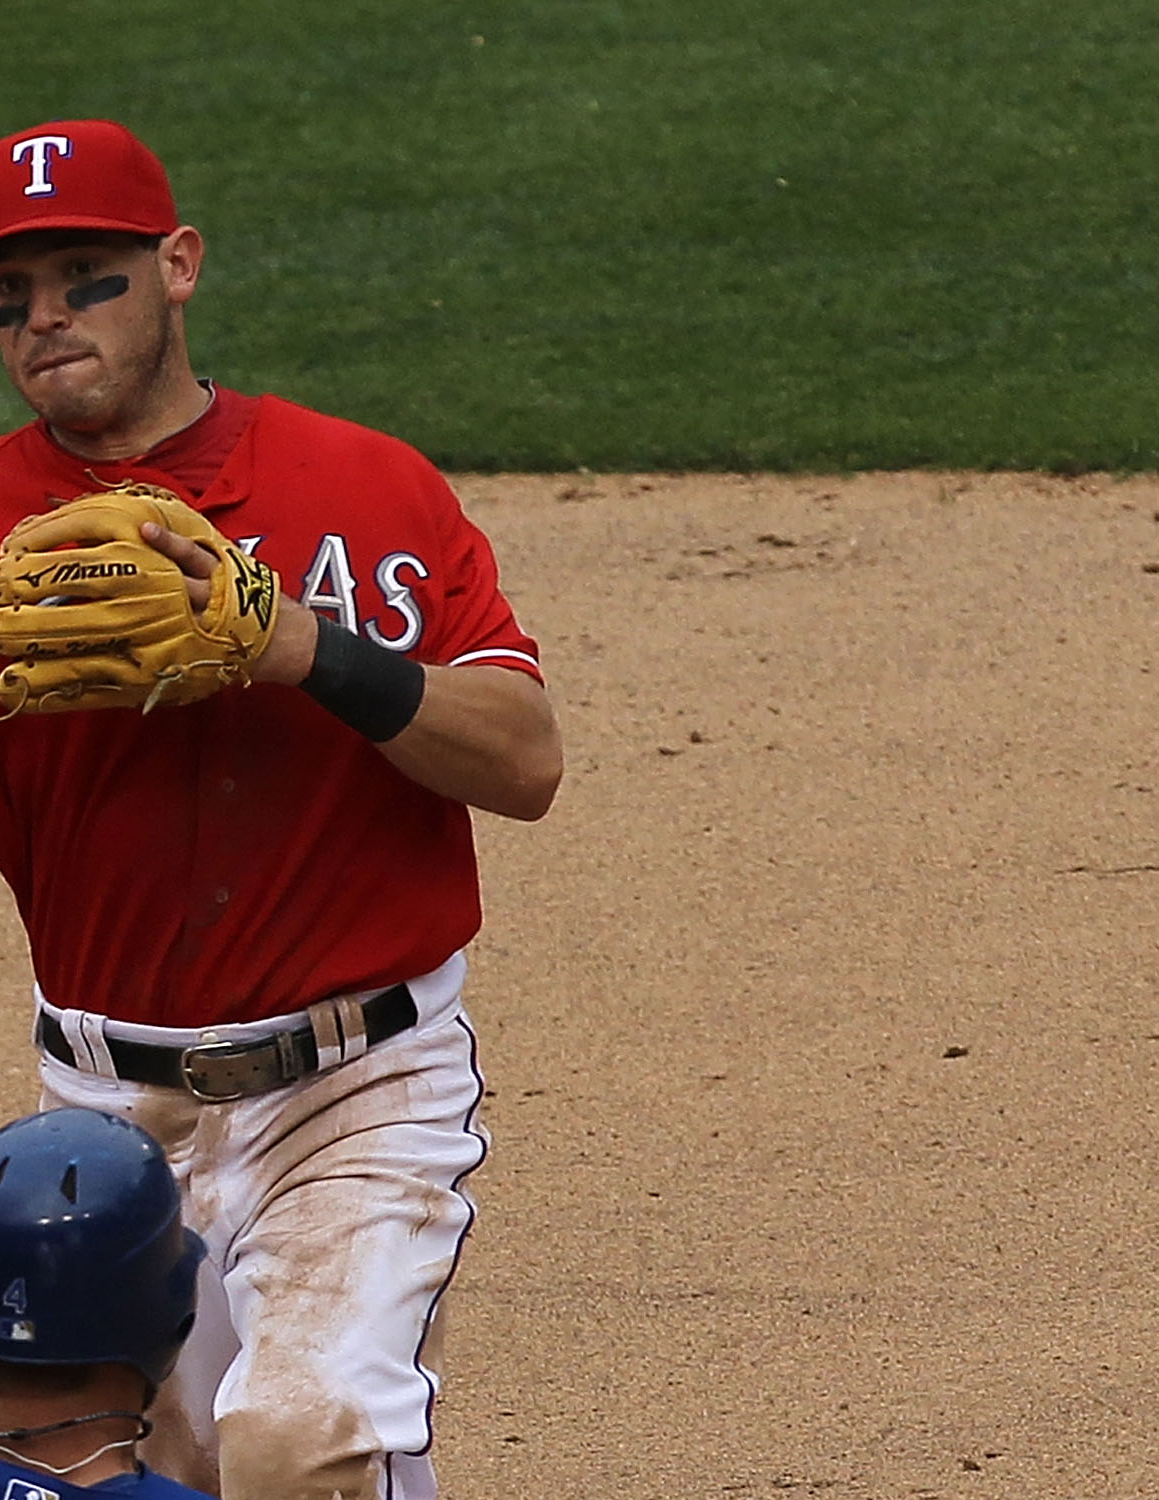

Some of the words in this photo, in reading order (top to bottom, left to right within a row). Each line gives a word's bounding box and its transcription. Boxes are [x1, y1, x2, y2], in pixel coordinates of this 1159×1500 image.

[12, 135, 72, 197] T
[237, 533, 430, 653] AS
[3, 1277, 27, 1314] 4
